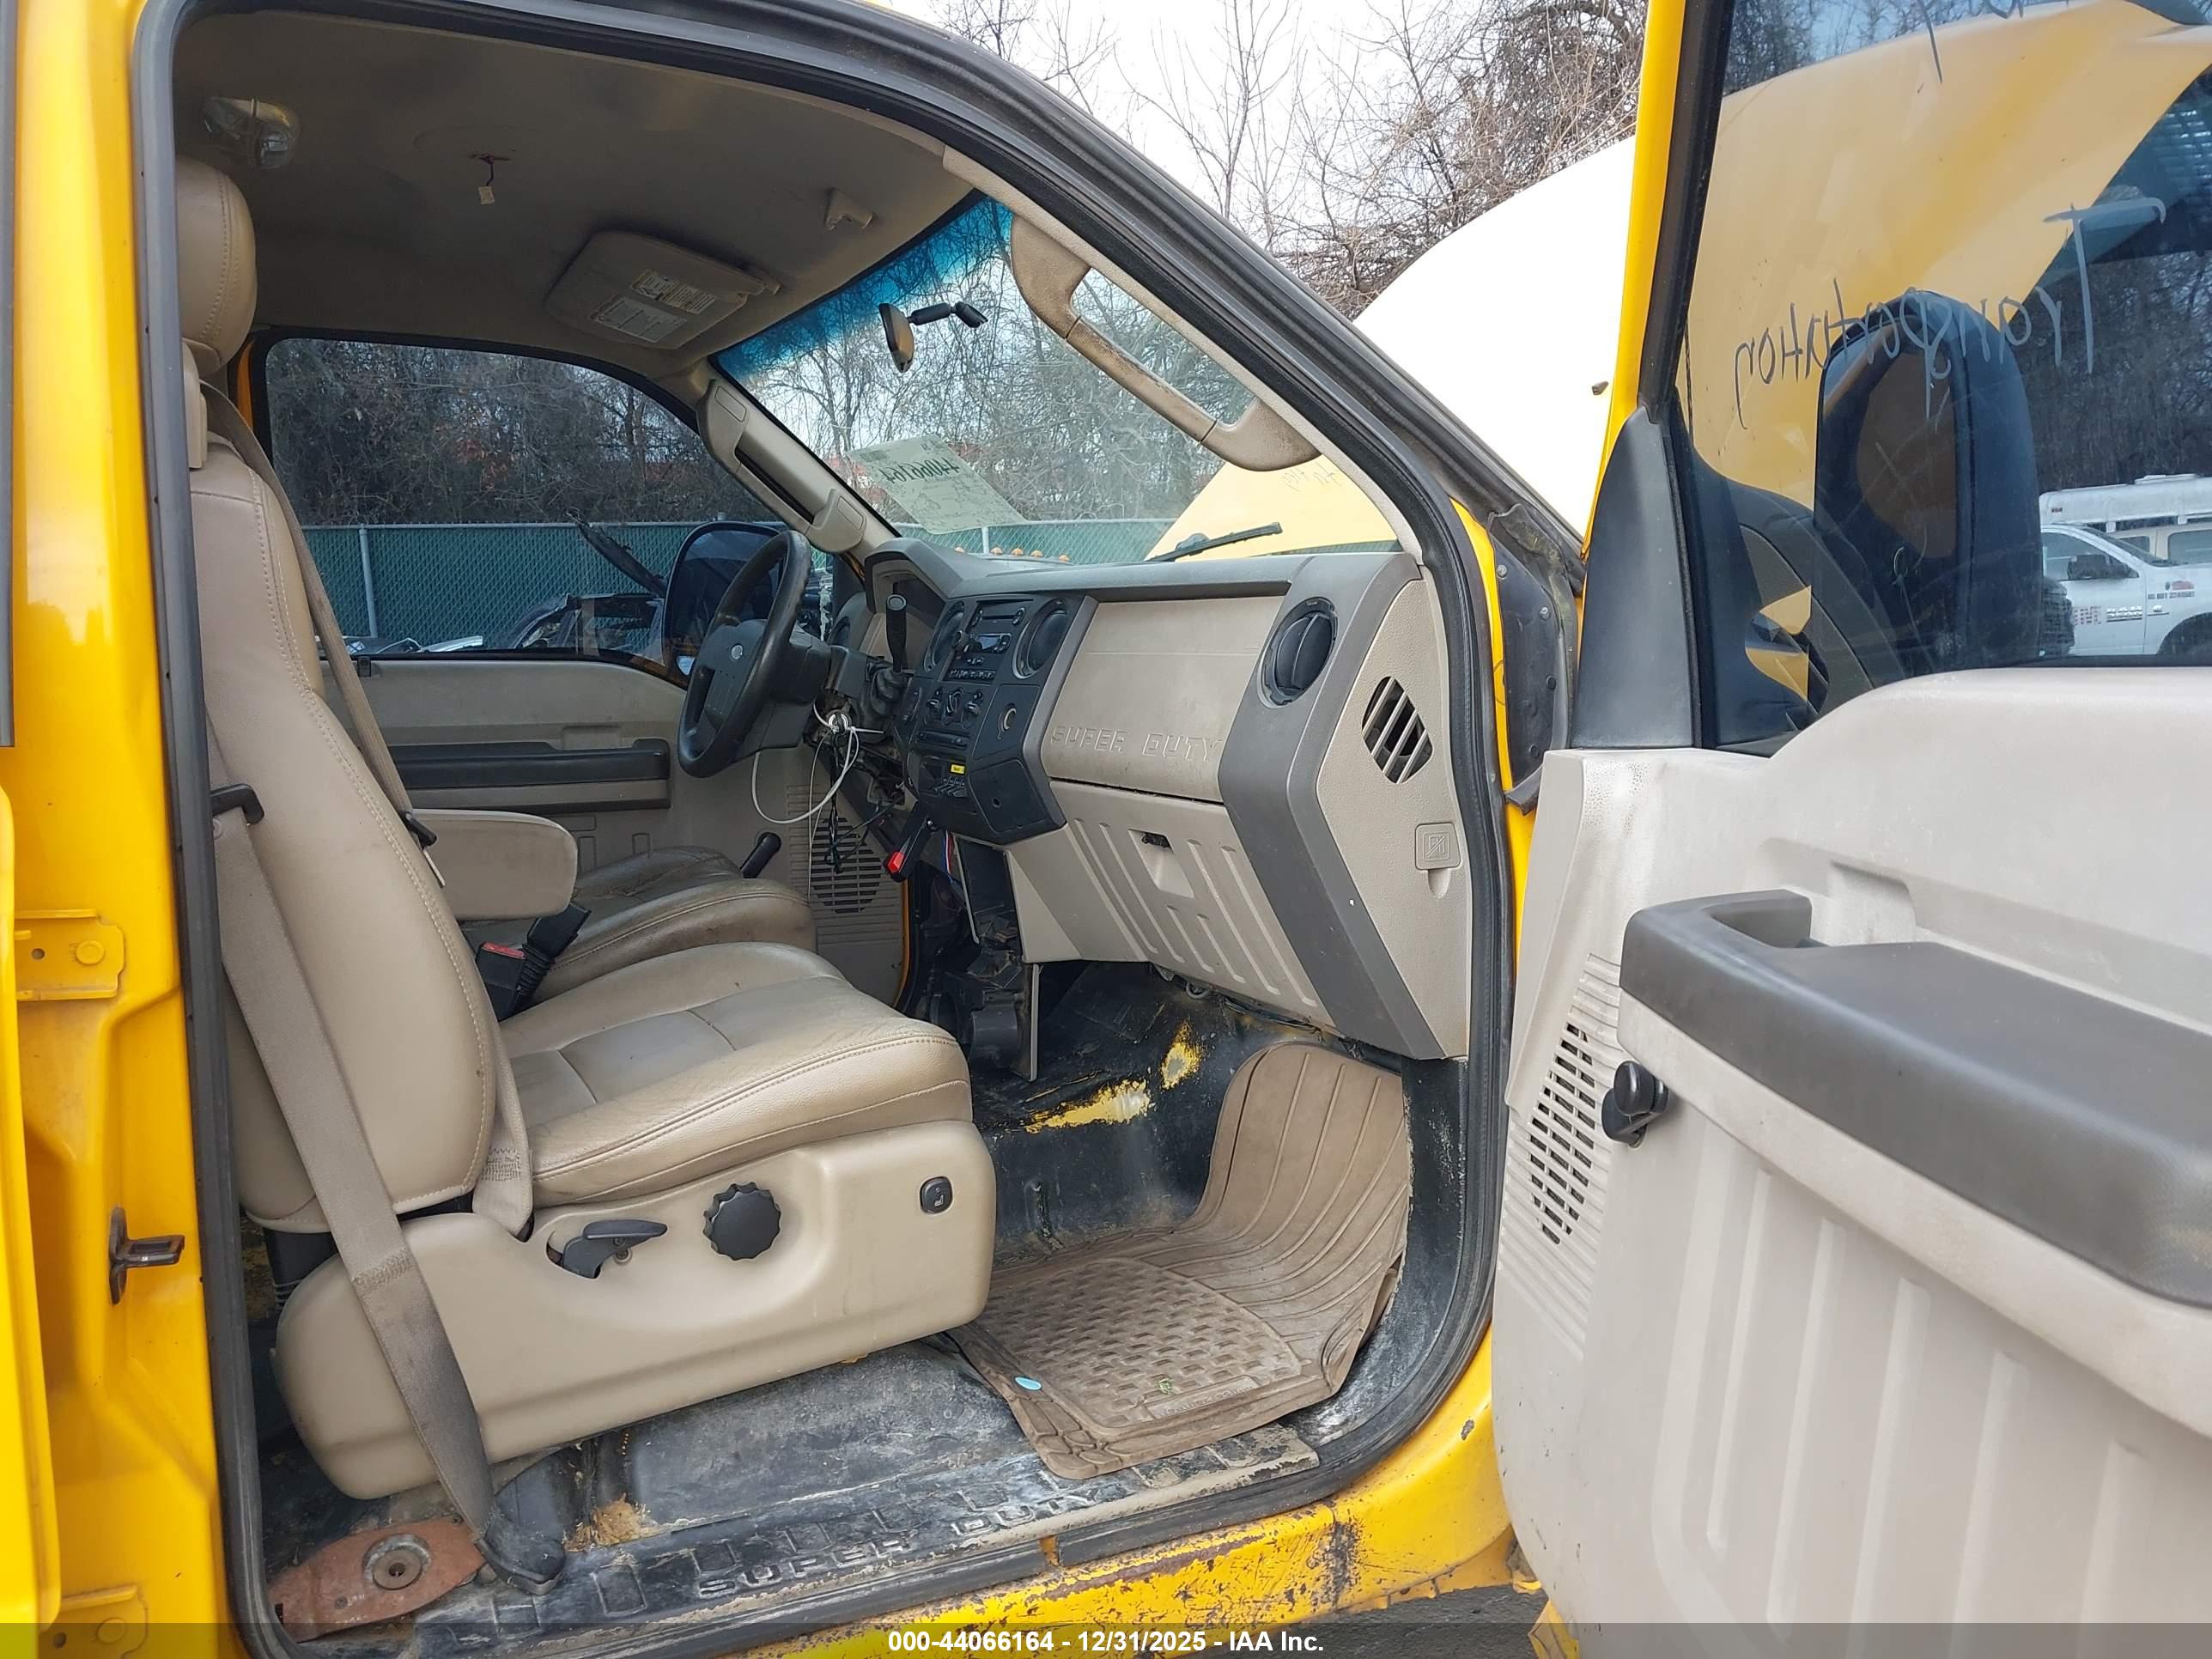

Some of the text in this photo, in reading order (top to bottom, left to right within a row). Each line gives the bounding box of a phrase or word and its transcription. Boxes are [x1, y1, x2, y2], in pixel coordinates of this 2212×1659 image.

[1052, 726, 1224, 762] SUPER DUTY
[698, 1487, 1103, 1597] SUPER DUTY
